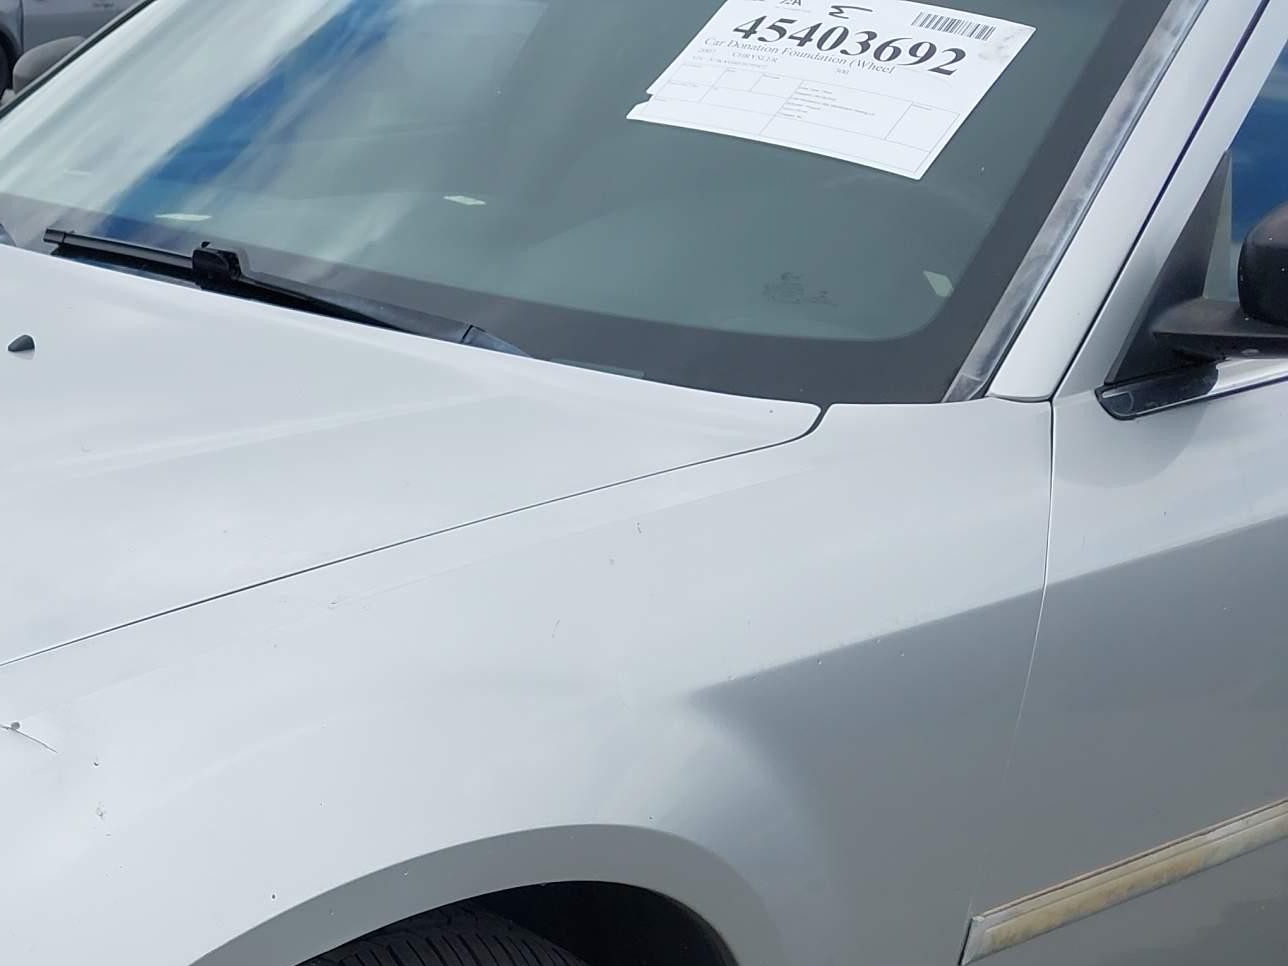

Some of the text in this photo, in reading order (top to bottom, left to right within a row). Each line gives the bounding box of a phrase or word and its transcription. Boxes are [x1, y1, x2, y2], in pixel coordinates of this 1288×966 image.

[704, 38, 725, 48] Car
[727, 39, 779, 55] Donation
[781, 46, 848, 66] Foundation
[849, 55, 896, 74] (Wheel
[732, 15, 967, 76] 45403692
